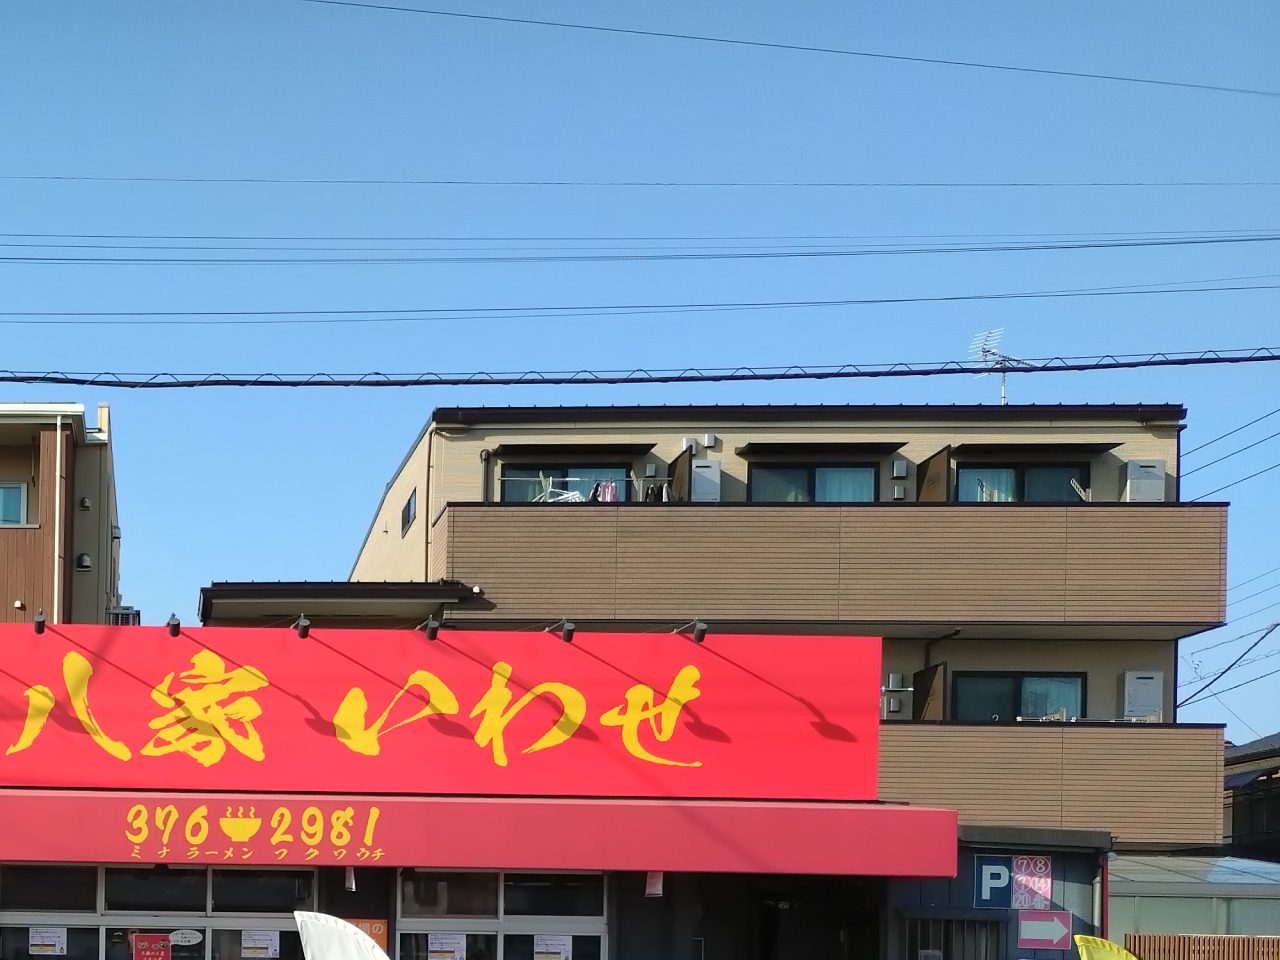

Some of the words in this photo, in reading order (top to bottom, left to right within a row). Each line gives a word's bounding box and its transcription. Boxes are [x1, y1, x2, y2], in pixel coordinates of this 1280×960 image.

[335, 661, 703, 768] いわせ
[125, 804, 209, 845] 376
[270, 806, 380, 846] 2981
[981, 865, 1010, 900] P
